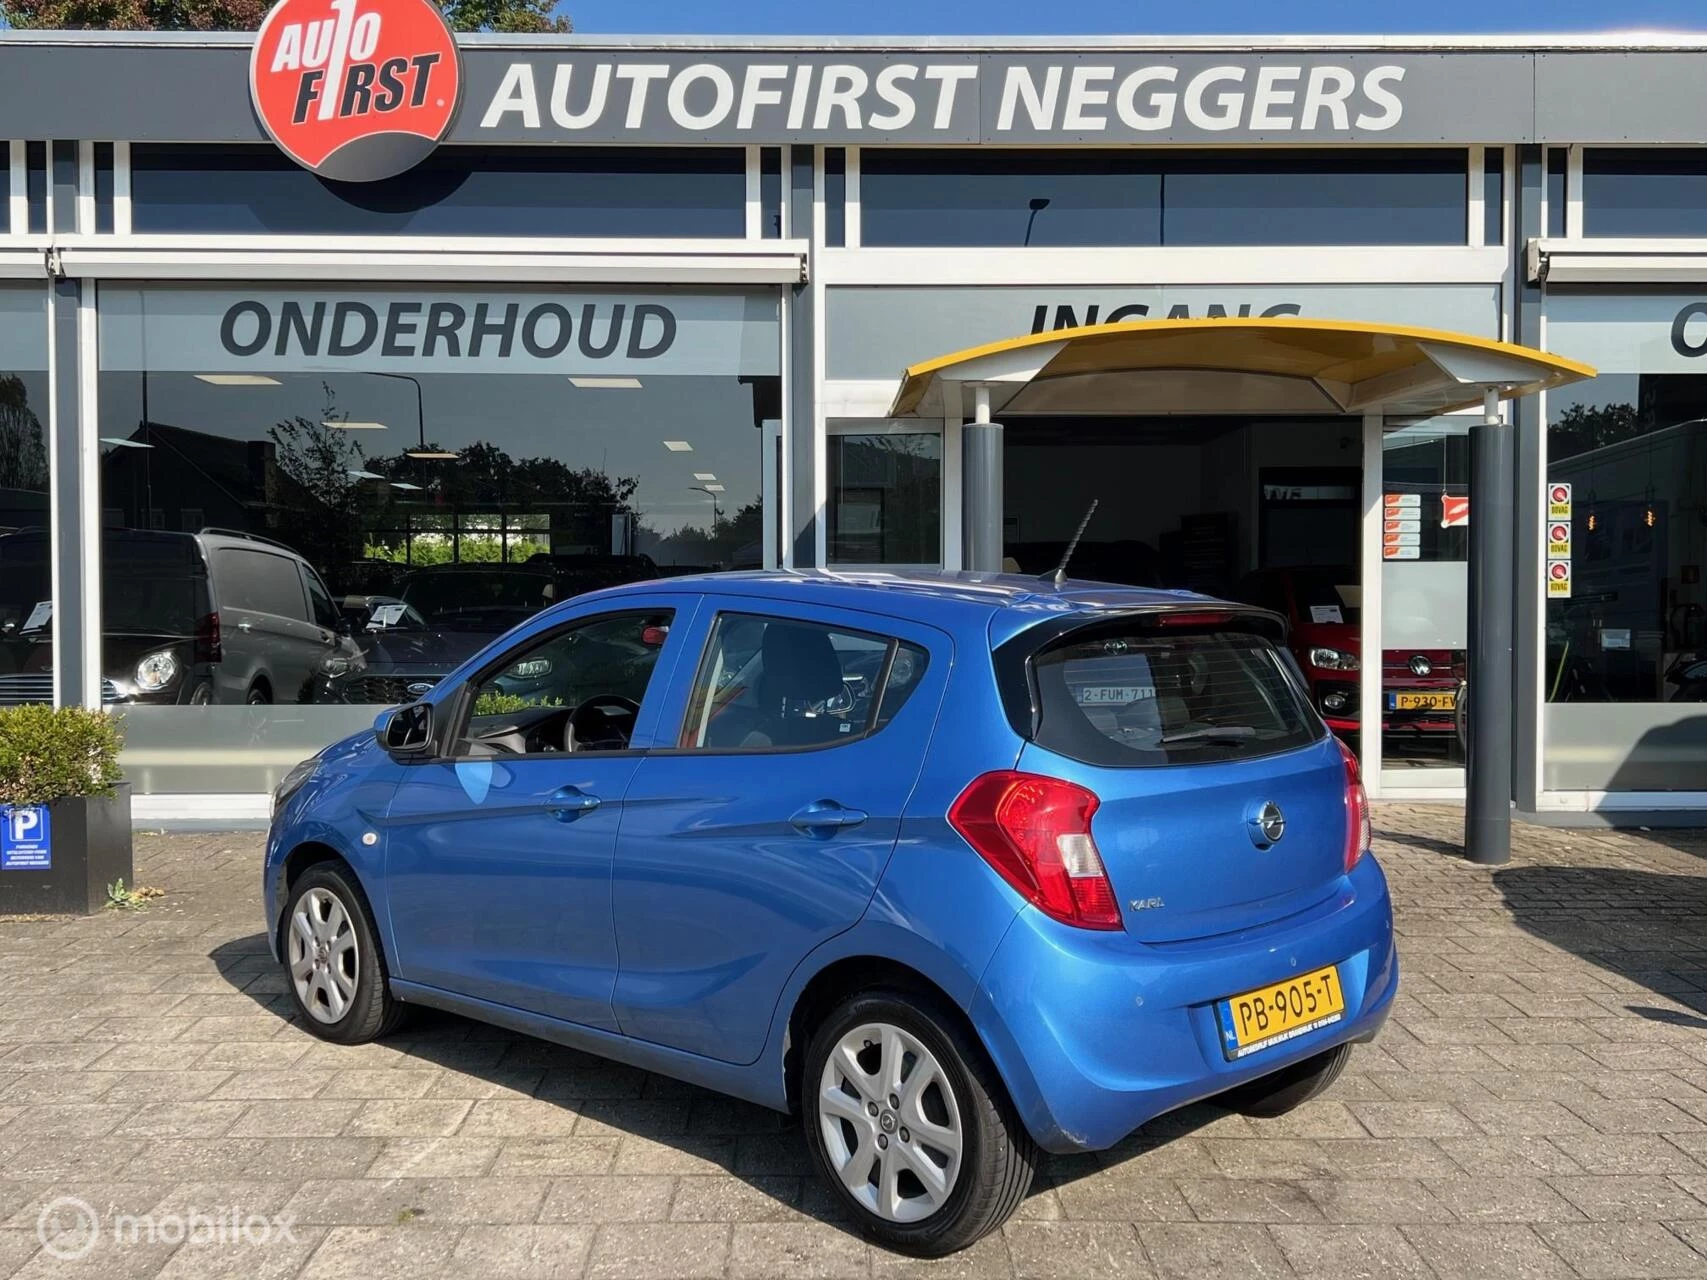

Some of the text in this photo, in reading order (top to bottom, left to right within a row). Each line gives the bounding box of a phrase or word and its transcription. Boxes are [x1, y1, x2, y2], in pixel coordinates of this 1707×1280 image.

[480, 64, 1406, 130] AUTOFIRST NEGGERS
[221, 301, 676, 358] ONDERHOUD
[15, 810, 38, 840] P
[1239, 974, 1333, 1037] PB-905-T
